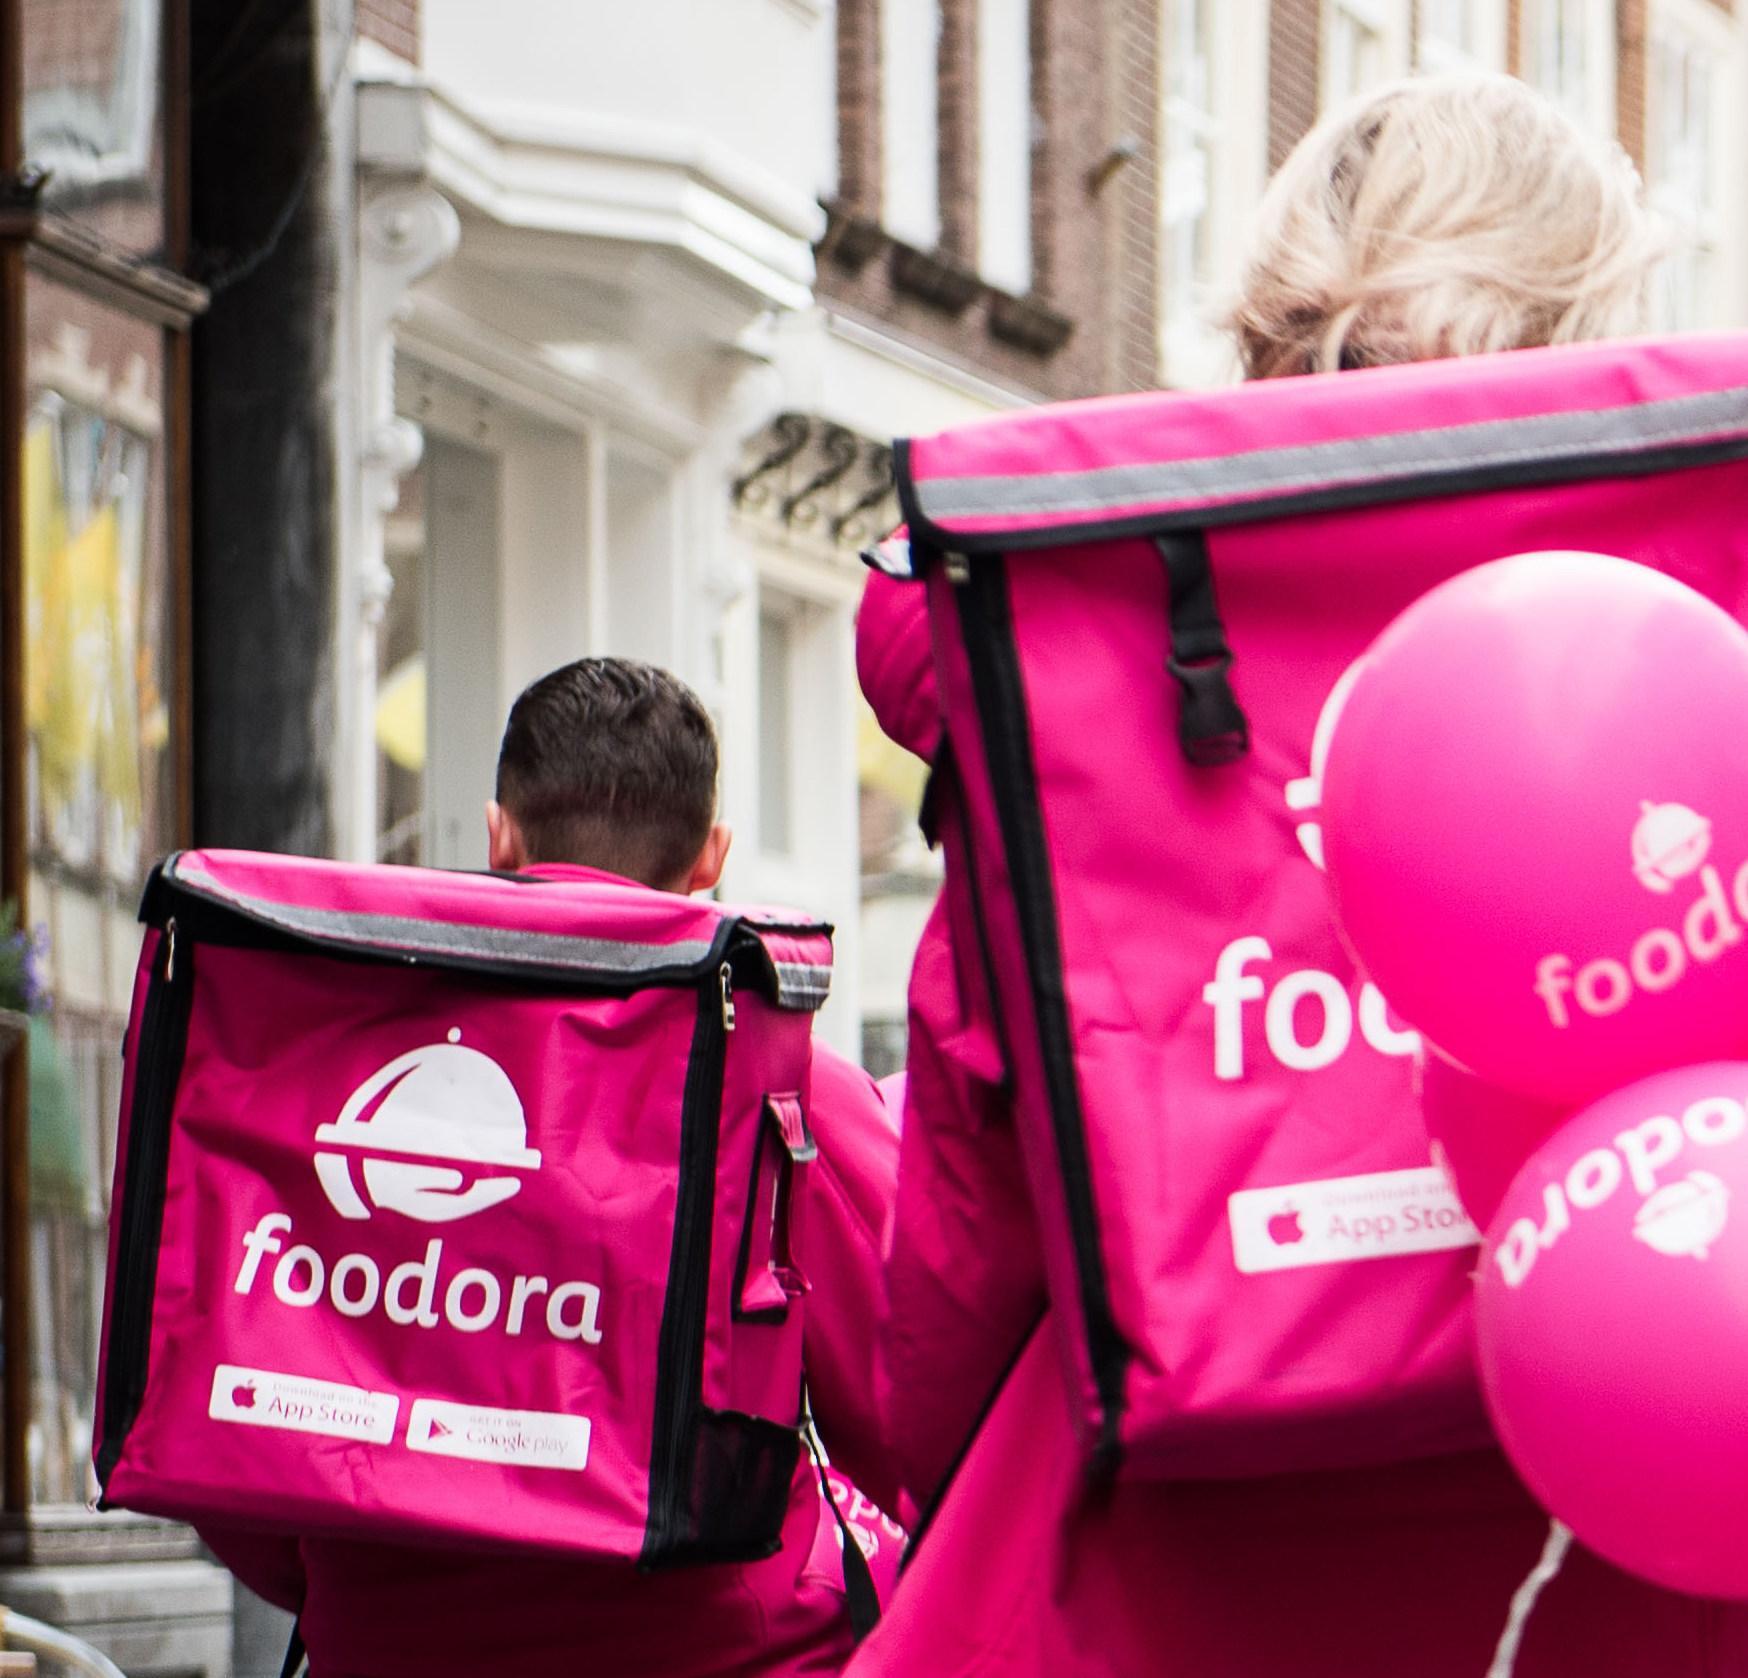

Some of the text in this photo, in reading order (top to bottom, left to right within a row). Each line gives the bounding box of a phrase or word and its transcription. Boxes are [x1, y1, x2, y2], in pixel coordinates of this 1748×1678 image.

[1327, 1214, 1397, 1242] App
[234, 1212, 603, 1345] foodora
[268, 1396, 375, 1428] App Store
[466, 1428, 569, 1454] Google play
